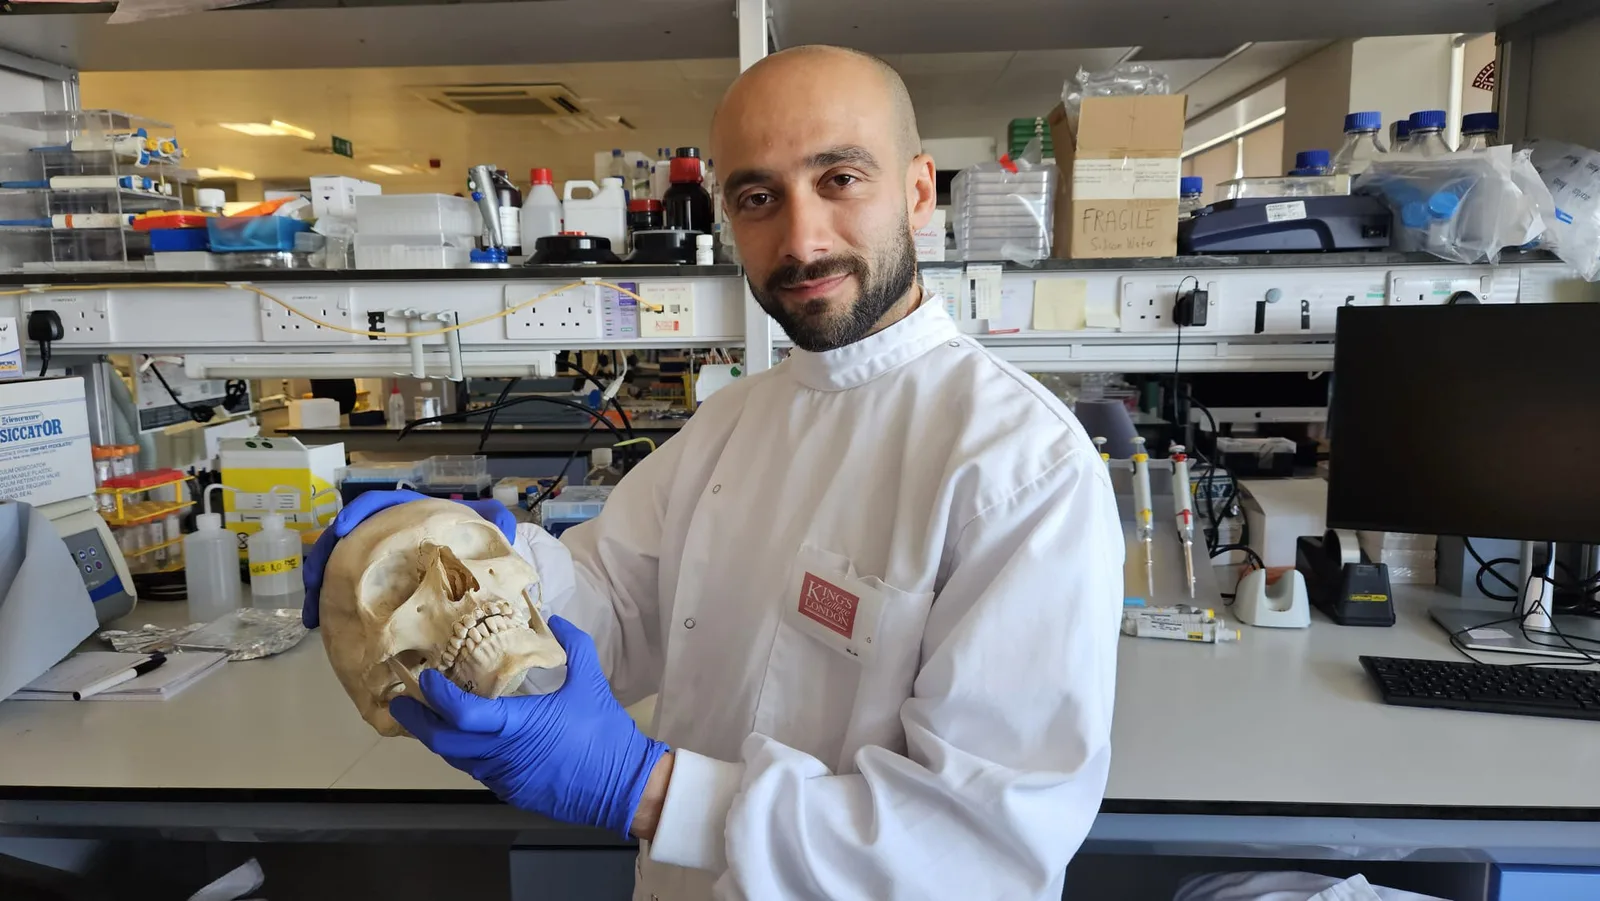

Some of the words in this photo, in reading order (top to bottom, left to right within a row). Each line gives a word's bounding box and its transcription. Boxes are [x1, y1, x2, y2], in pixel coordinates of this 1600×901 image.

[1082, 208, 1160, 234] FRAGILE
[1126, 236, 1157, 251] Wafer
[0, 419, 62, 443] SICCATOR
[16, 474, 46, 485] RETENTION
[26, 480, 52, 490] REQUIRED
[20, 490, 32, 498] SEAL
[807, 580, 852, 609] KING'S
[805, 598, 848, 626] LONDON
[820, 597, 851, 617] College
